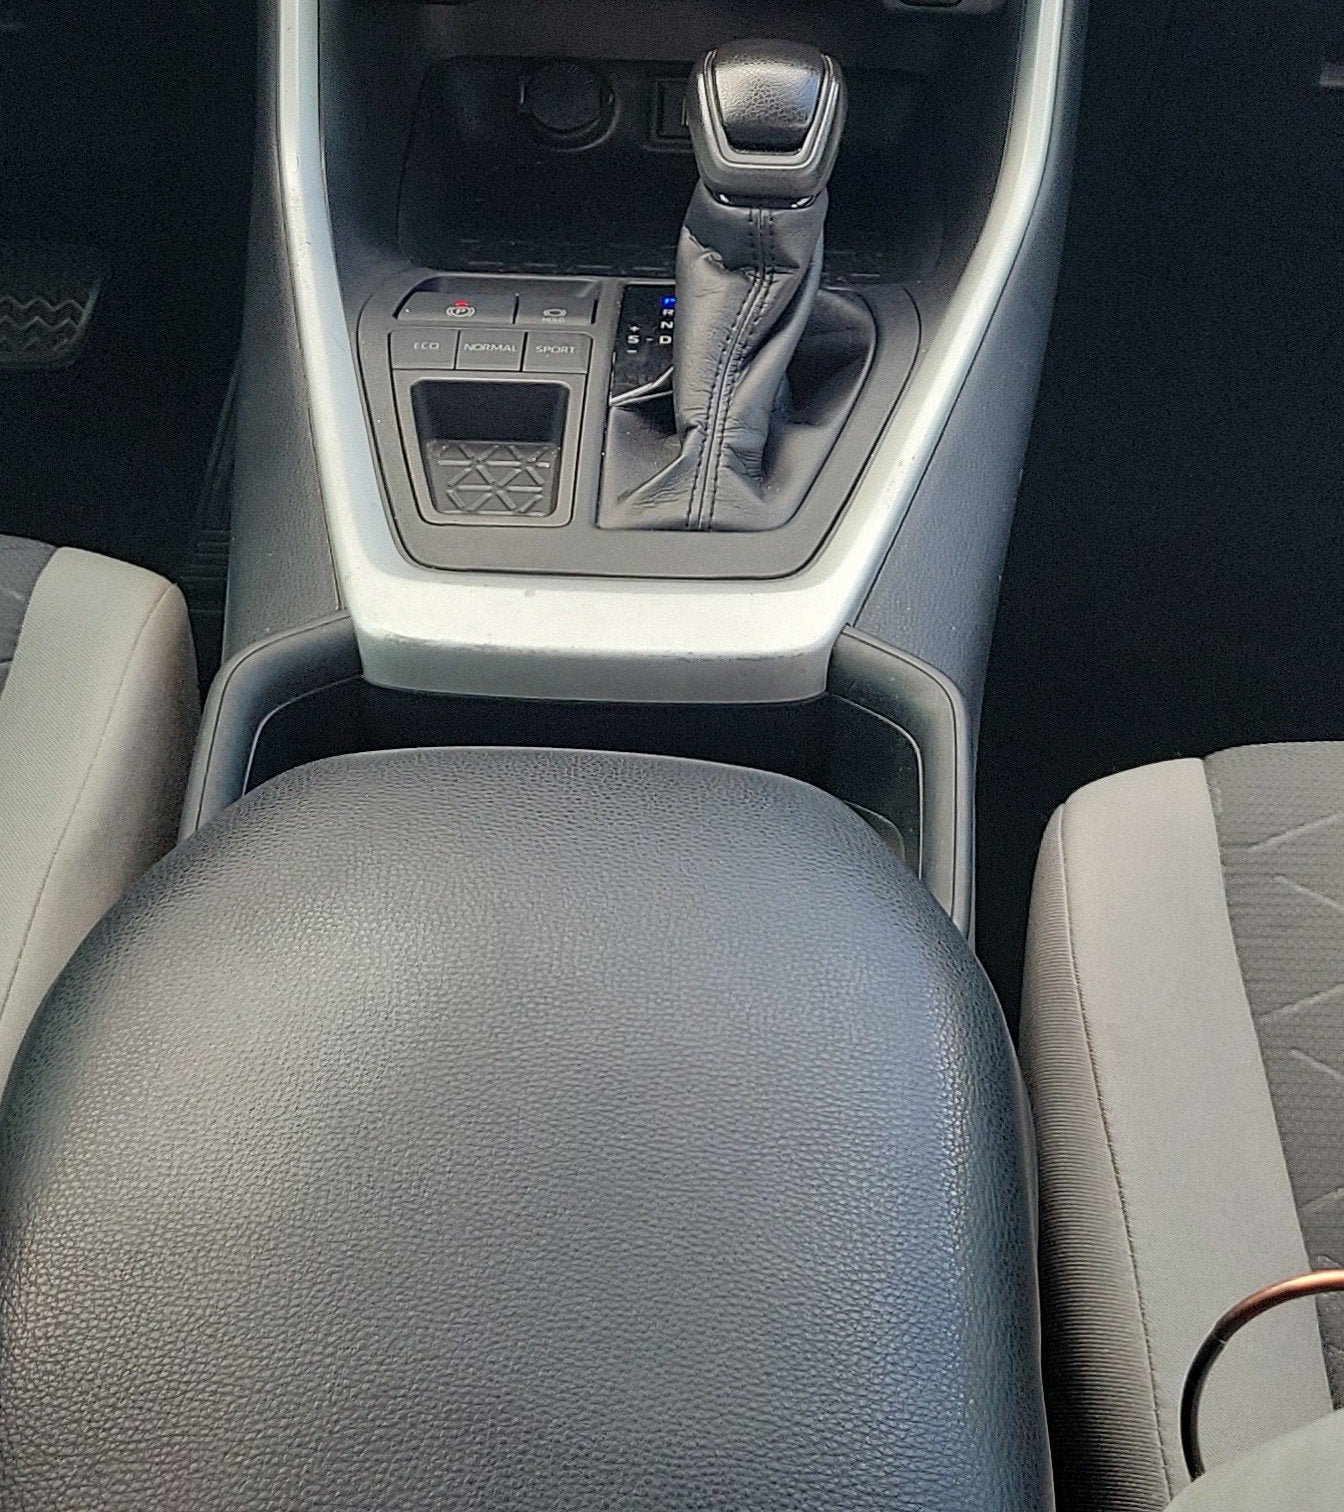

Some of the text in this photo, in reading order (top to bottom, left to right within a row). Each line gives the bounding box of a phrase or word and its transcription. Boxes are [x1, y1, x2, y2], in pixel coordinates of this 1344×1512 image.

[662, 309, 674, 317] R
[660, 321, 673, 329] N
[627, 334, 640, 344] S
[659, 335, 672, 345] D
[413, 341, 440, 350] ECO
[464, 343, 517, 352] NORMAL
[535, 345, 576, 354] SPORT
